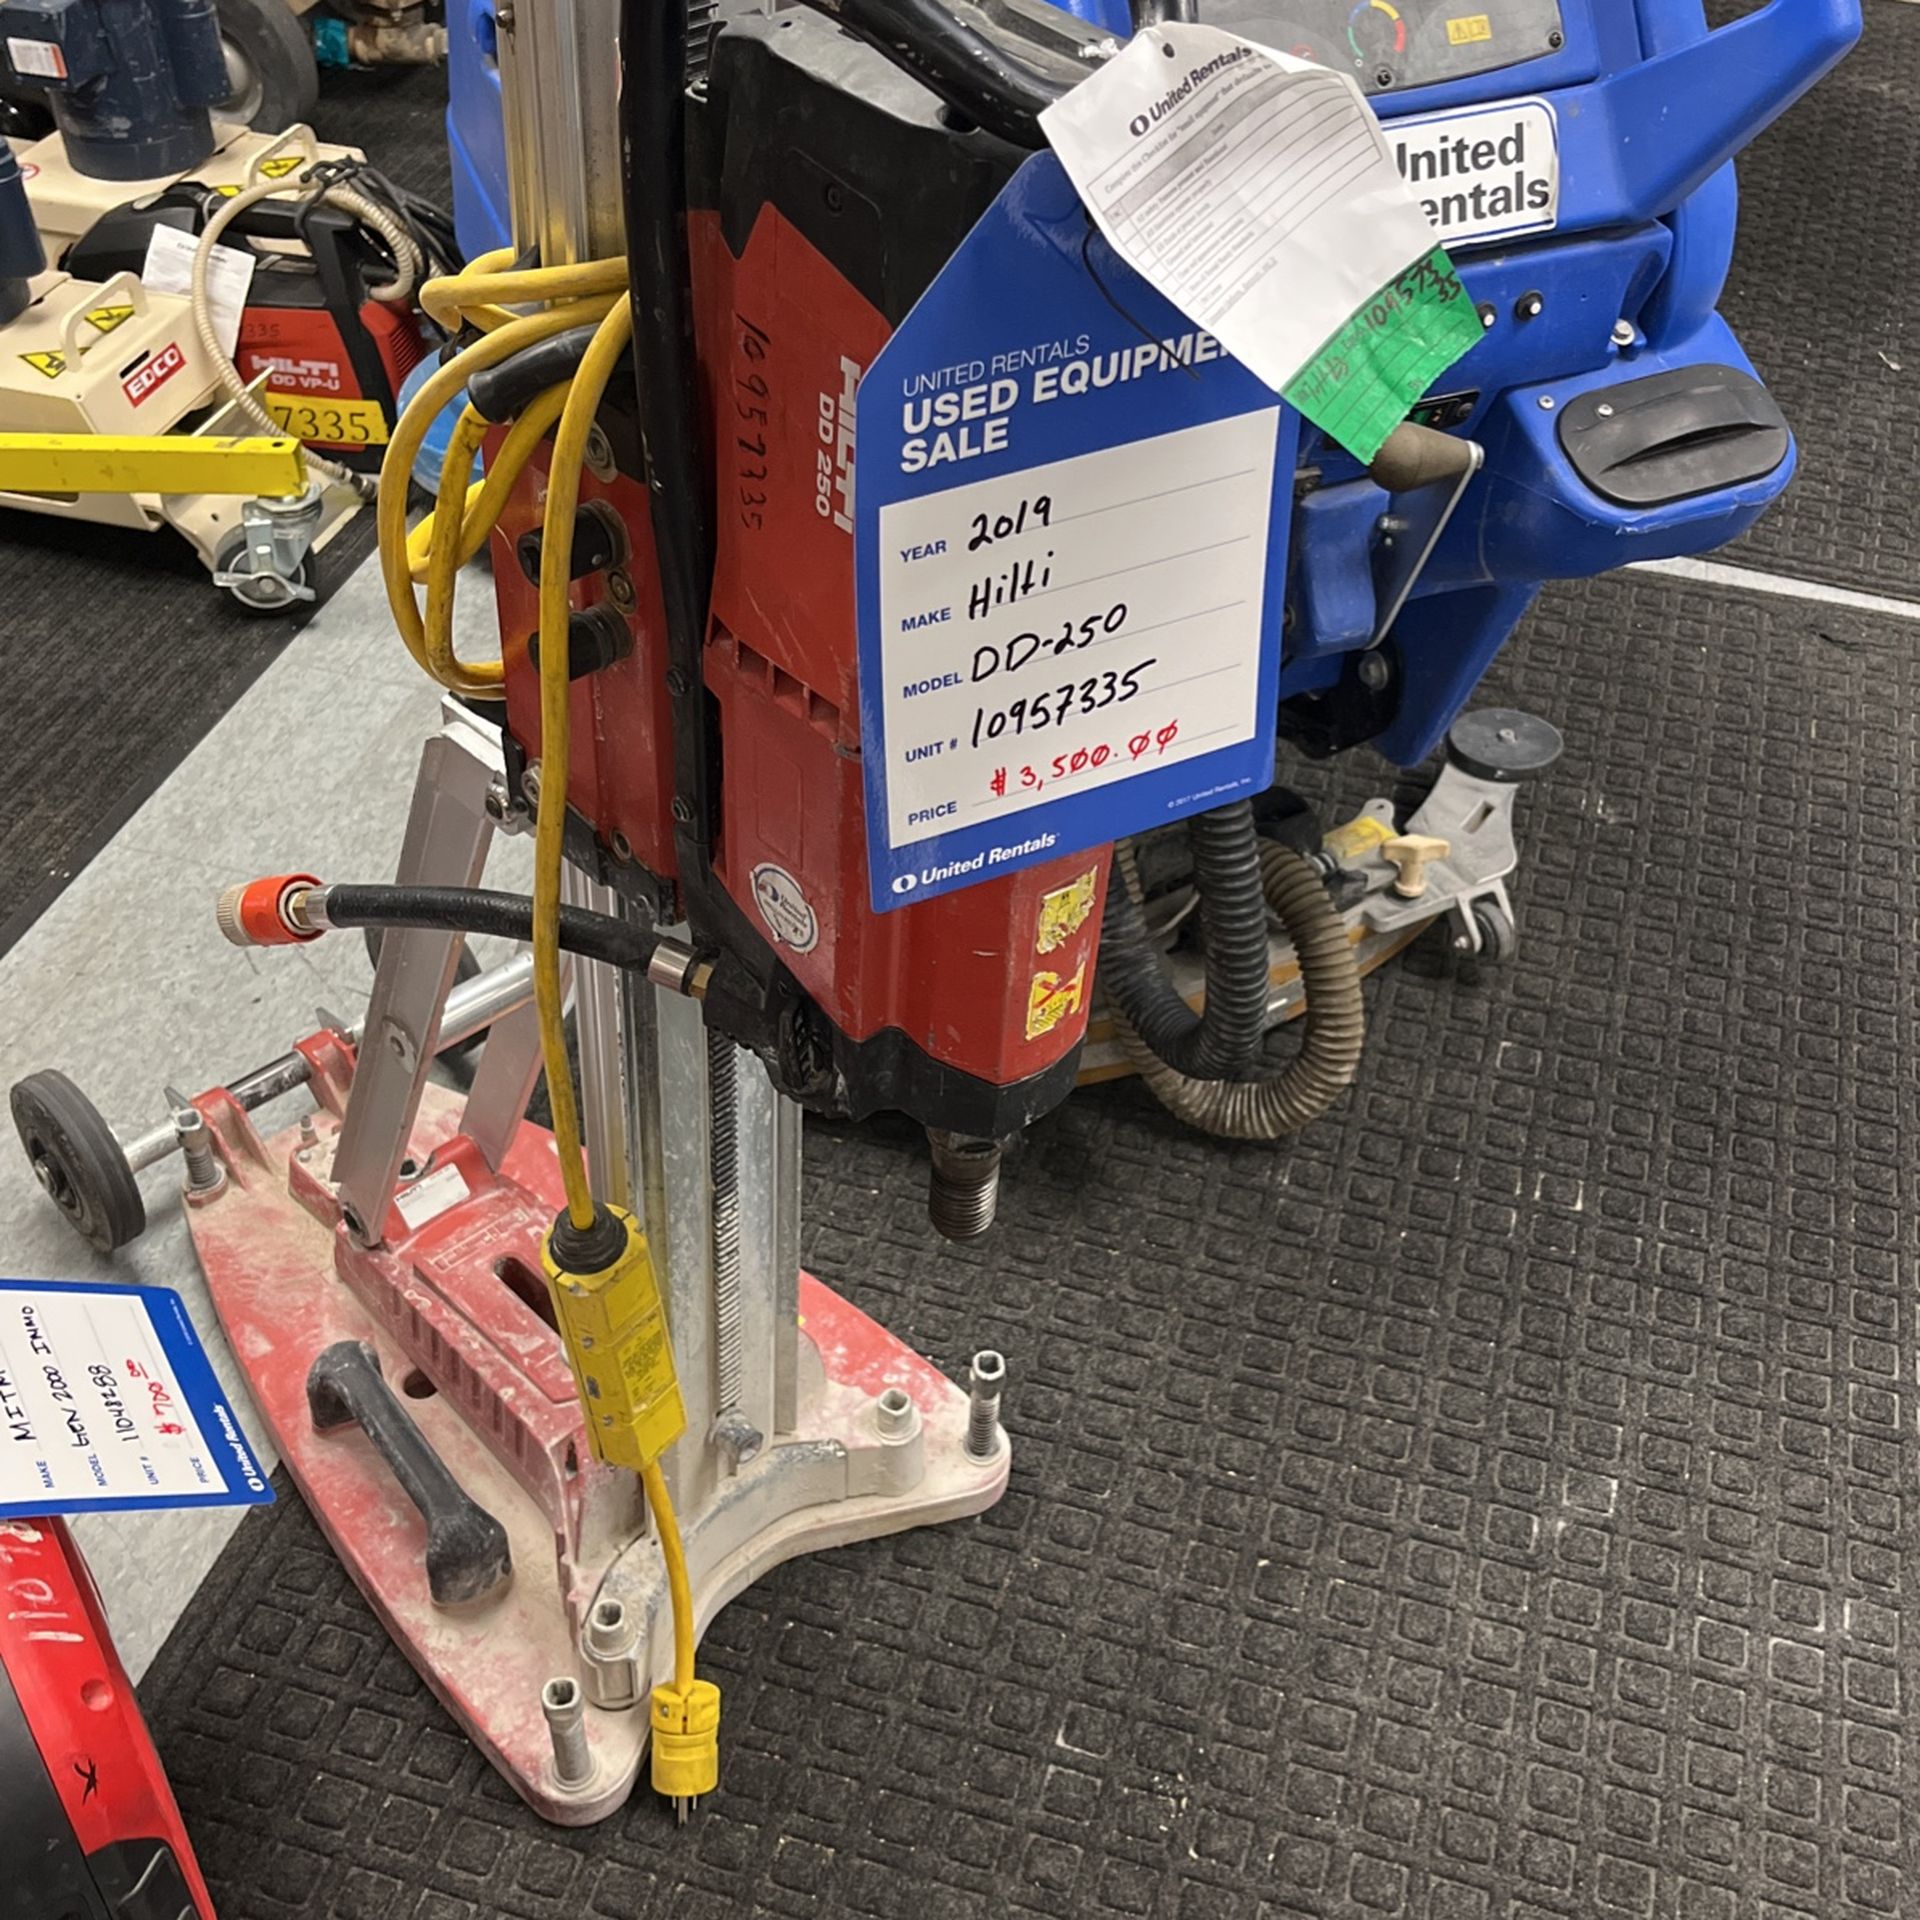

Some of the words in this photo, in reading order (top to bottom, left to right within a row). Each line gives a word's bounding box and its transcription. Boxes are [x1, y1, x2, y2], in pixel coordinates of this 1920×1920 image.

[1149, 77, 1192, 122] United
[1189, 46, 1252, 87] Rentals
[1420, 171, 1550, 228] entals
[126, 347, 180, 399] EDCO
[251, 355, 338, 377] HILTI
[271, 373, 296, 386] DD
[300, 377, 340, 391] VP-U
[903, 378, 1018, 435] USED
[1033, 330, 1233, 404] EQUIPME
[904, 361, 984, 397] UNITED
[992, 334, 1090, 376] RENTALS
[274, 406, 369, 442] 7335
[819, 392, 834, 444] DD
[834, 355, 861, 534] HILTI
[901, 417, 1009, 473] SALE
[815, 449, 832, 517] 250
[901, 540, 947, 563] YEAR
[968, 496, 1052, 551] 2019
[901, 608, 951, 632] MAKE
[968, 550, 1055, 619] Hilti
[903, 672, 963, 698] MODEL
[972, 603, 1127, 683] DD-250
[905, 742, 943, 763] UNIT
[949, 738, 958, 750] #
[973, 658, 1156, 748] 10957335
[907, 801, 957, 826] PRICE
[921, 856, 984, 885] United
[988, 833, 1056, 863] Rentals
[42, 1365, 74, 1402] 2000
[213, 1404, 240, 1441] Rentals
[36, 1460, 55, 1489] MAKE
[88, 1453, 108, 1486] MODEL
[142, 1463, 159, 1485] UNIT
[189, 1456, 209, 1484] PRICE
[229, 1442, 257, 1476] United
